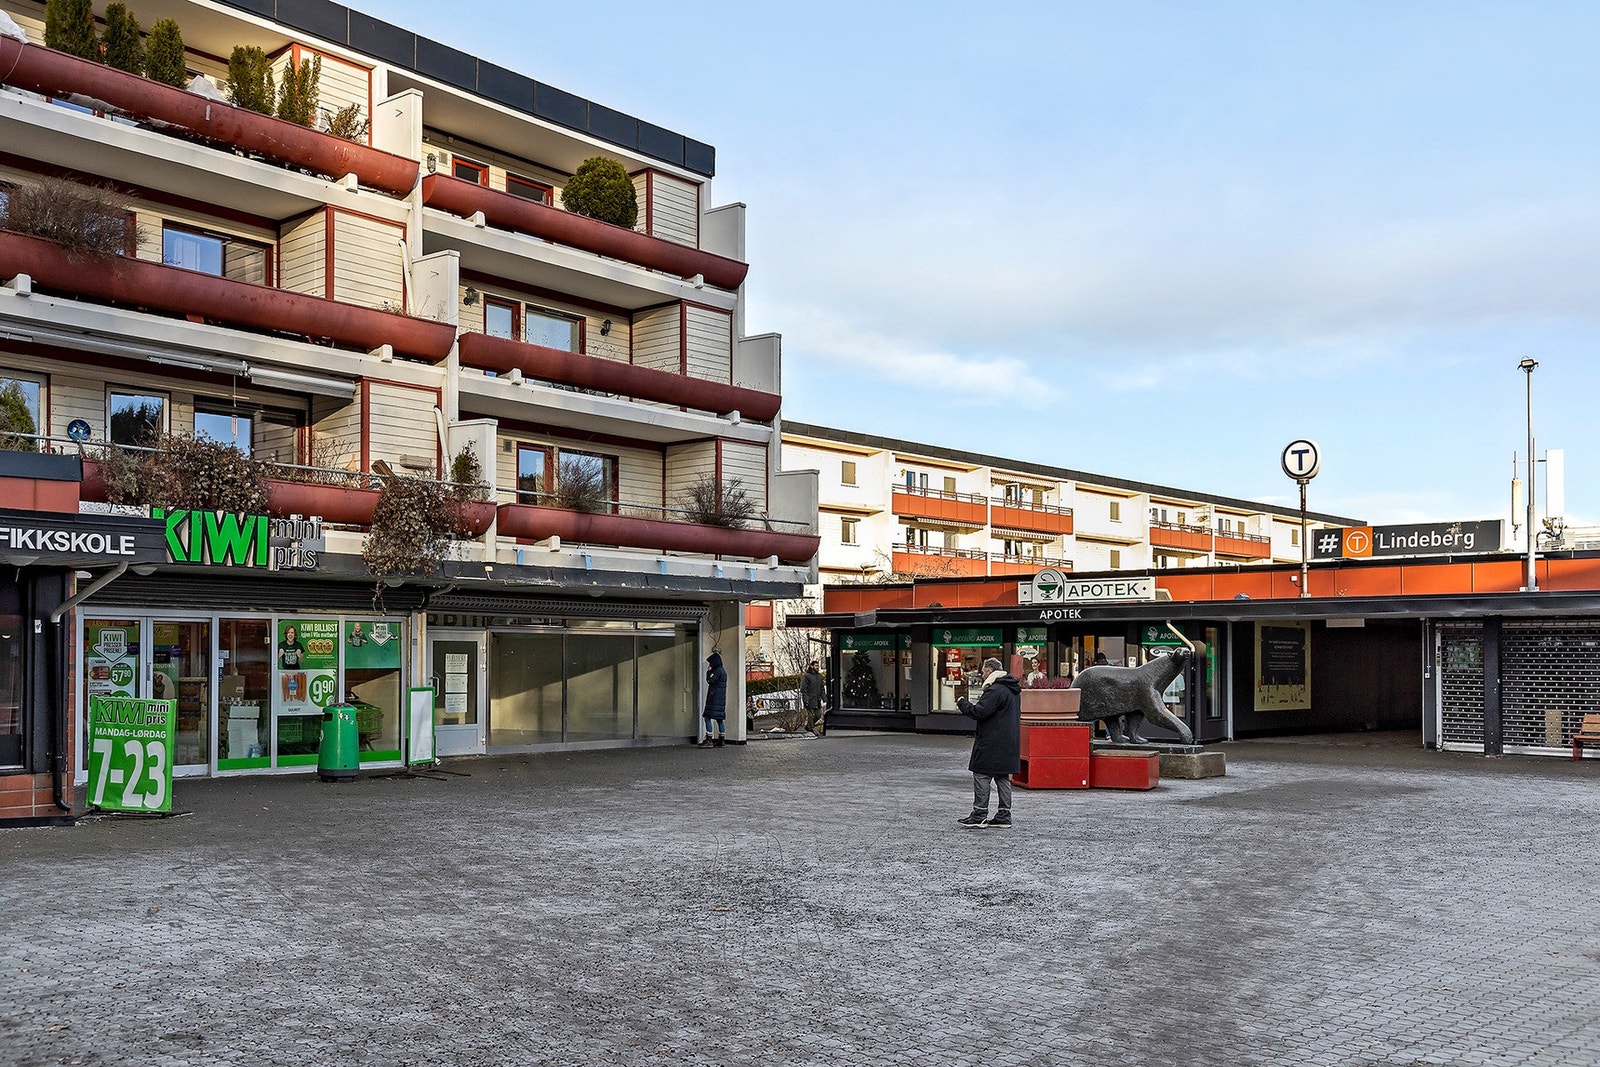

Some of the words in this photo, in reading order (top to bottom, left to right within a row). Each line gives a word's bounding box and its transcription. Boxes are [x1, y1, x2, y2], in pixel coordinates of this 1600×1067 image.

[1290, 448, 1310, 471] T
[152, 506, 269, 567] KIWI
[274, 513, 324, 541] mini
[1379, 530, 1476, 549] Lindeberg
[272, 544, 317, 571] pris
[1067, 582, 1140, 598] APOTEK
[1039, 608, 1082, 620] APOTEK
[103, 633, 122, 642] KIWI
[96, 699, 146, 724] KIWI
[147, 701, 169, 713] mini
[146, 714, 166, 726] pris
[94, 727, 167, 739] MANDAG-LØRDAG
[92, 738, 166, 809] 7-23
